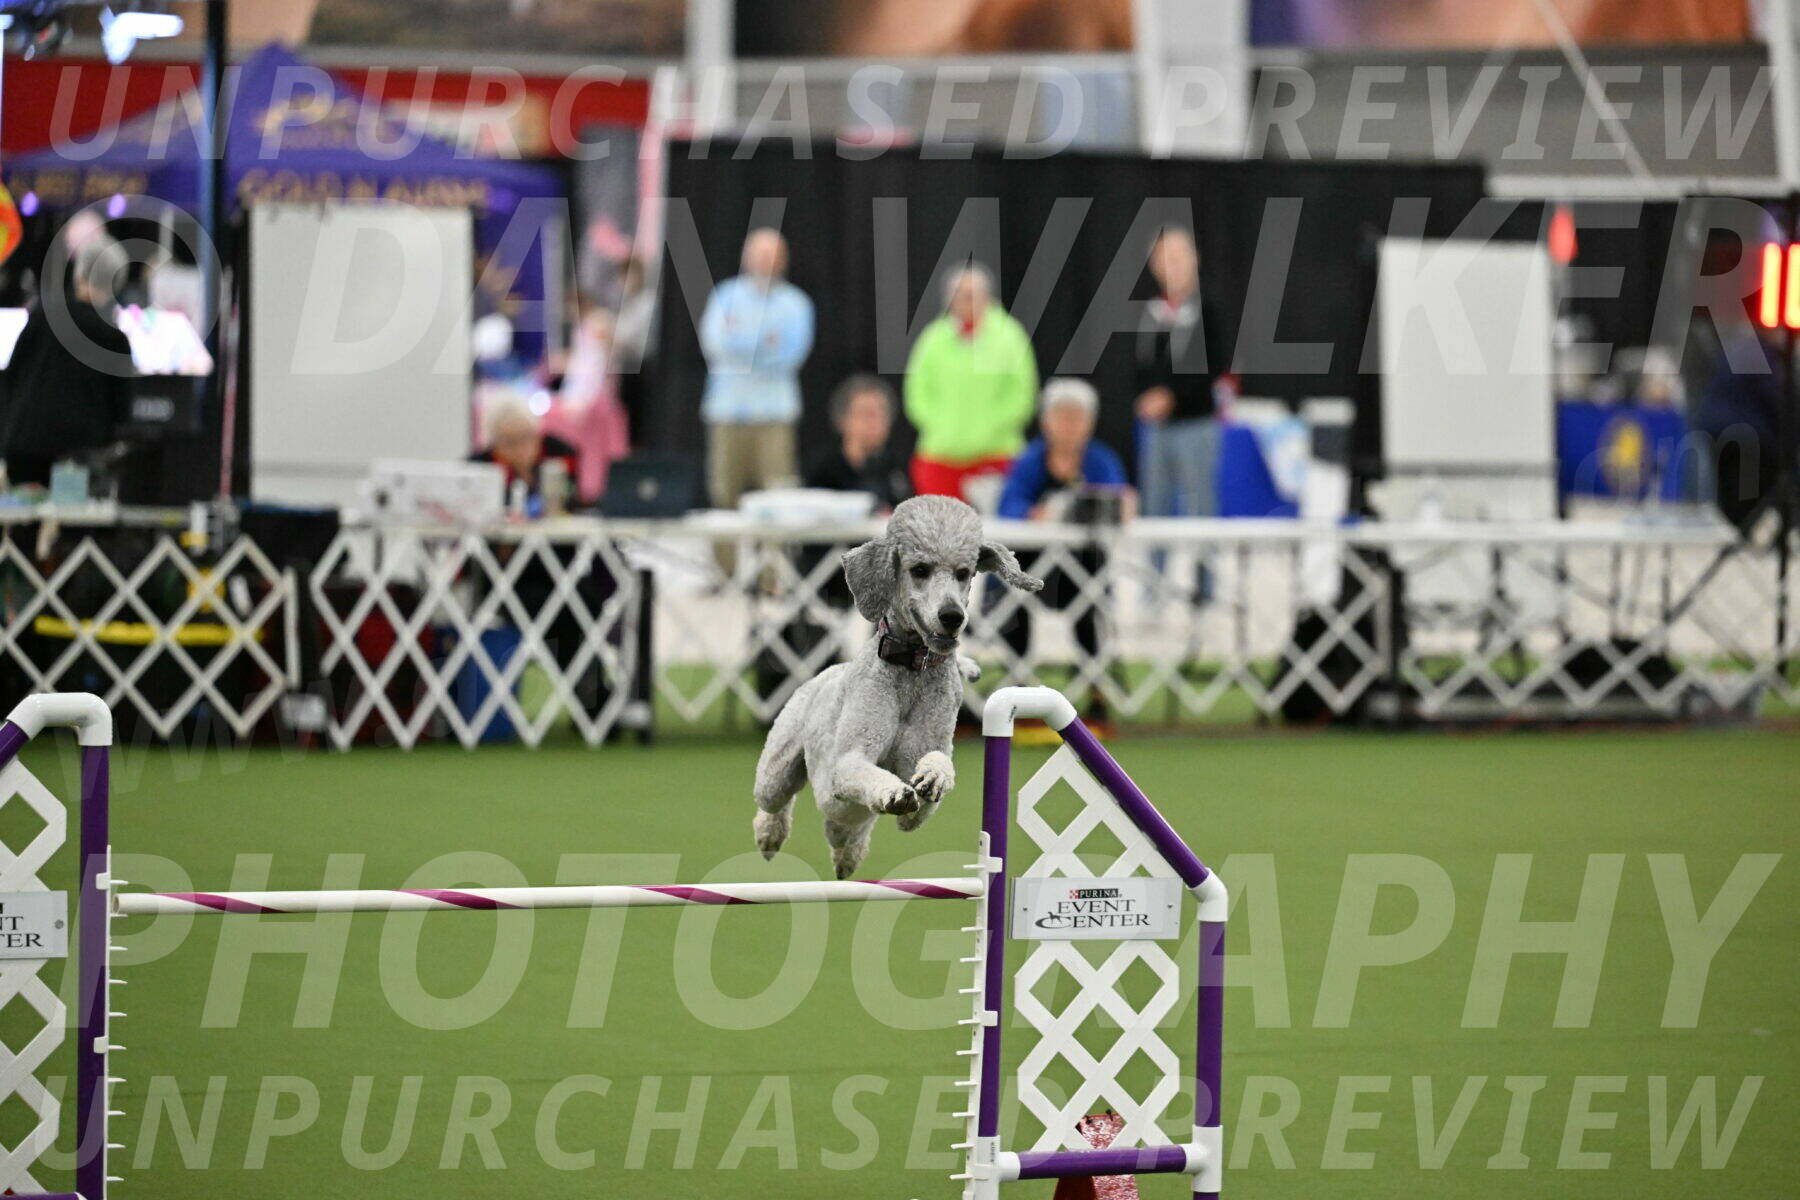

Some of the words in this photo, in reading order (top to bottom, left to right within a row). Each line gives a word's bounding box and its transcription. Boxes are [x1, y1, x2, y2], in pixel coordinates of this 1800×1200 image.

[1079, 889, 1118, 898] PURINA
[1057, 899, 1136, 914] EVENT
[1034, 913, 1150, 929] CENTER
